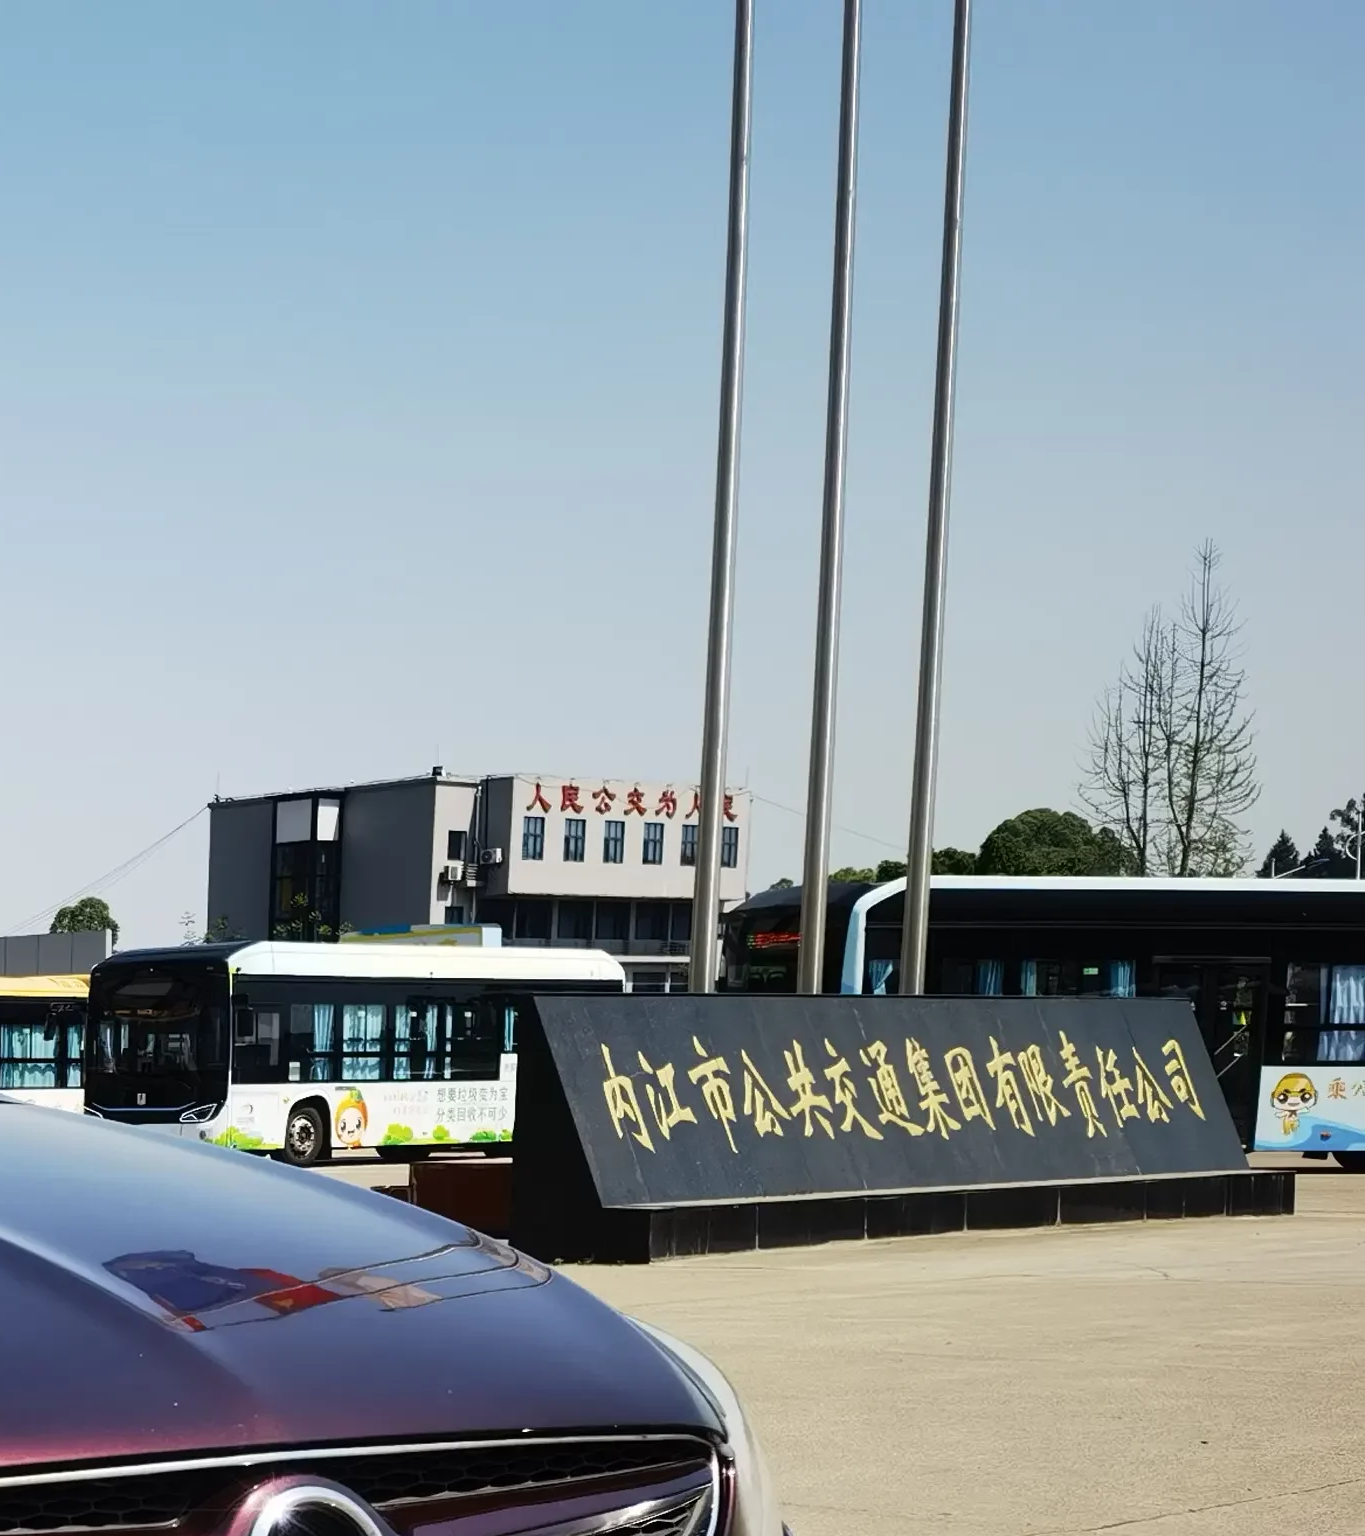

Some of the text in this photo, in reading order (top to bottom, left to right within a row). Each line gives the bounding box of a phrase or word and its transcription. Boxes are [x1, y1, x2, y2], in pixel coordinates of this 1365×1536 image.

[602, 1031, 1205, 1153] 内江市公共交通集团有限责任公司
